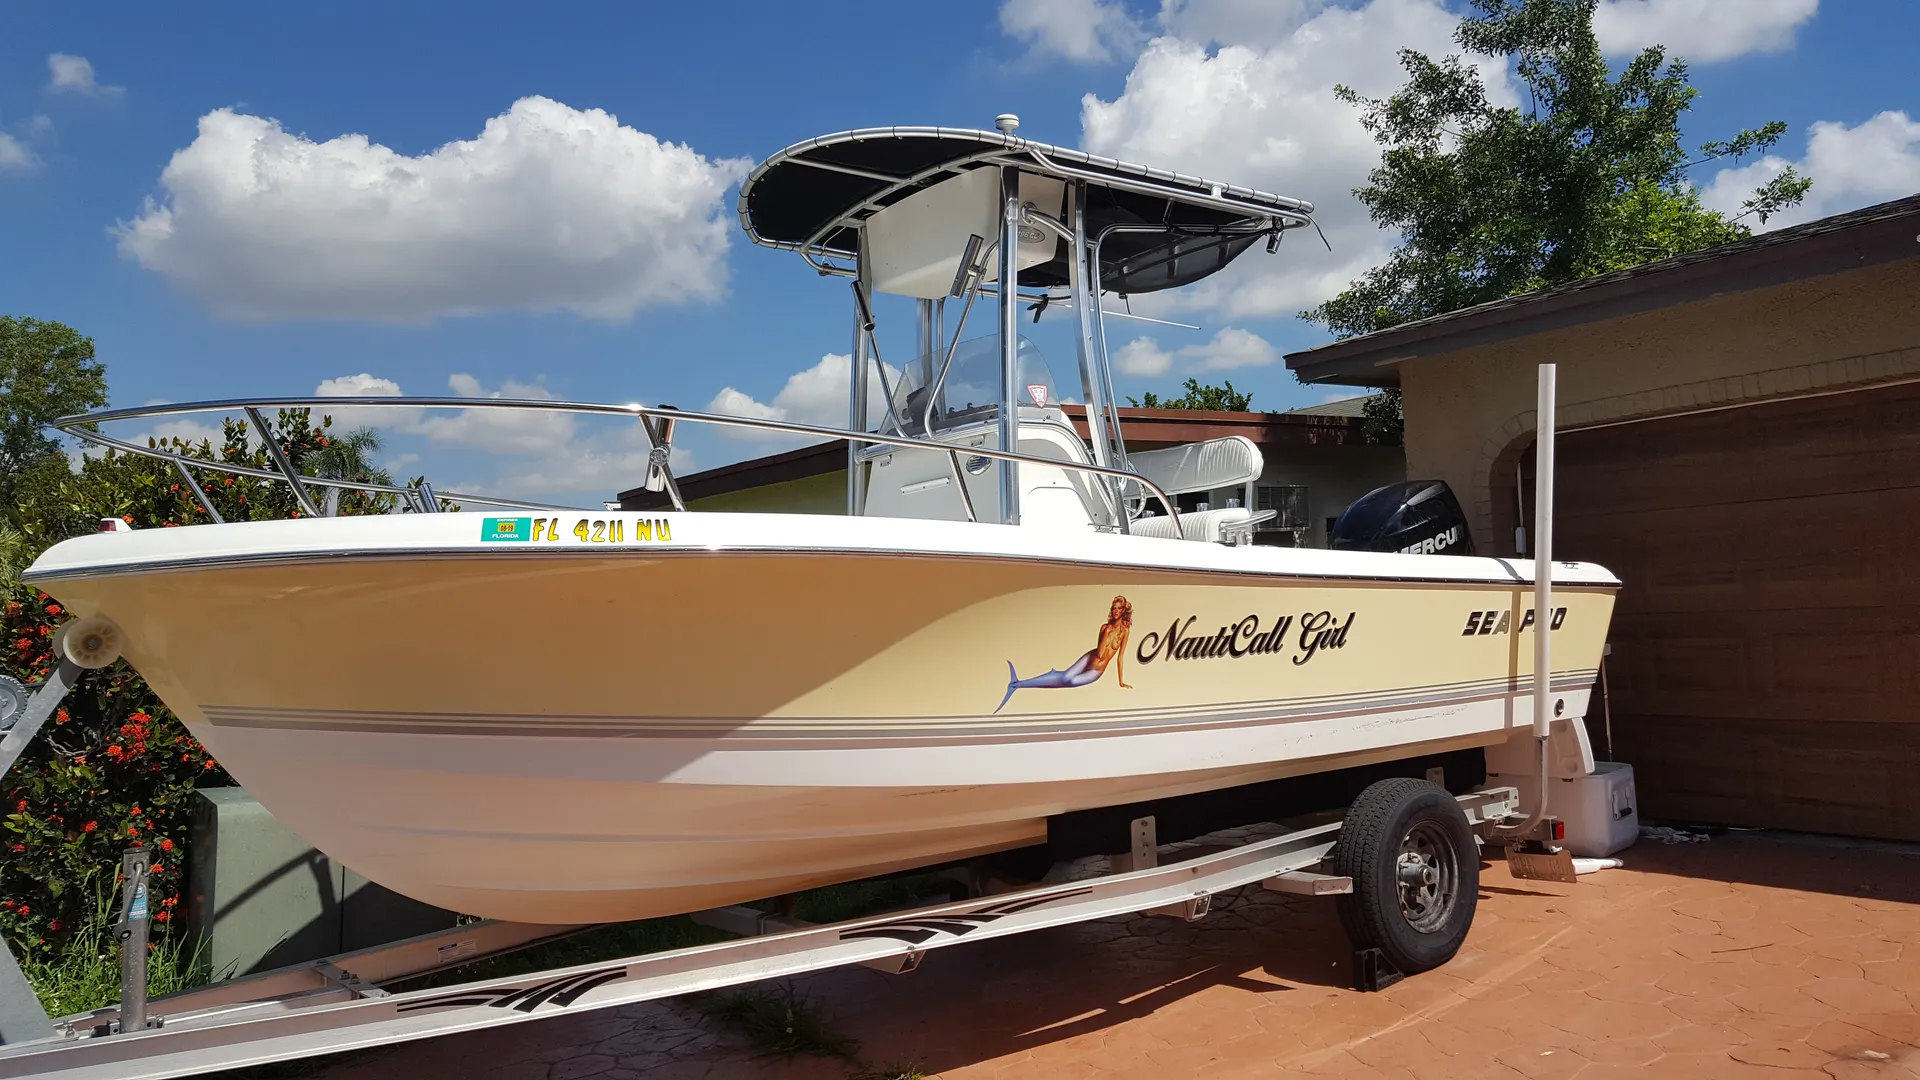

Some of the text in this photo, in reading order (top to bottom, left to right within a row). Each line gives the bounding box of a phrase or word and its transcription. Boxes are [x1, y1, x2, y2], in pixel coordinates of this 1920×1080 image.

[532, 518, 672, 542] FL 4211 NU
[1392, 524, 1465, 555] ERCUR
[1461, 607, 1567, 636] SEA PO
[1136, 610, 1356, 666] NautiCall Girl
